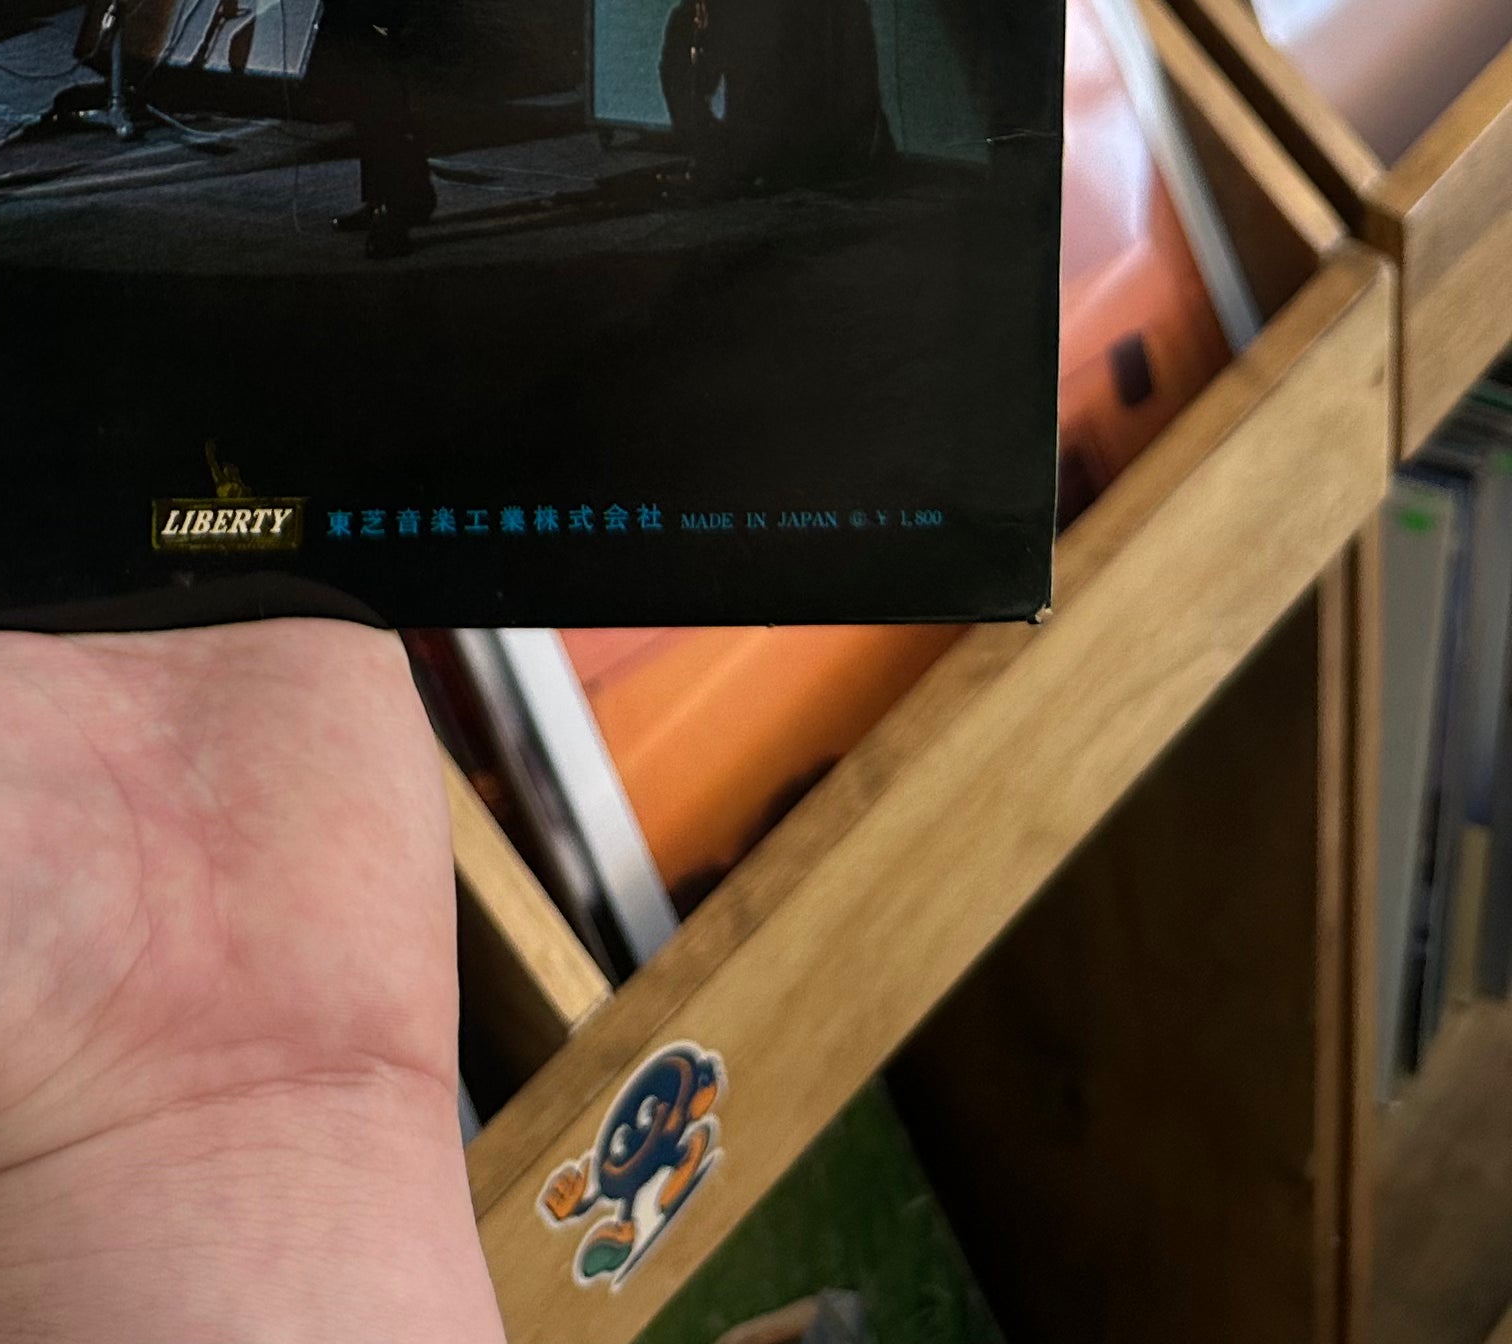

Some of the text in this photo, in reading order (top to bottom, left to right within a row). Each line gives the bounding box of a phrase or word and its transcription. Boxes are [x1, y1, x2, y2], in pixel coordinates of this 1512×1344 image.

[160, 508, 293, 537] LIBERTY
[326, 503, 663, 537] 東芝音楽工業株式会社
[681, 512, 733, 529] MADE
[746, 512, 767, 529] IN
[777, 511, 838, 528] JAPAN
